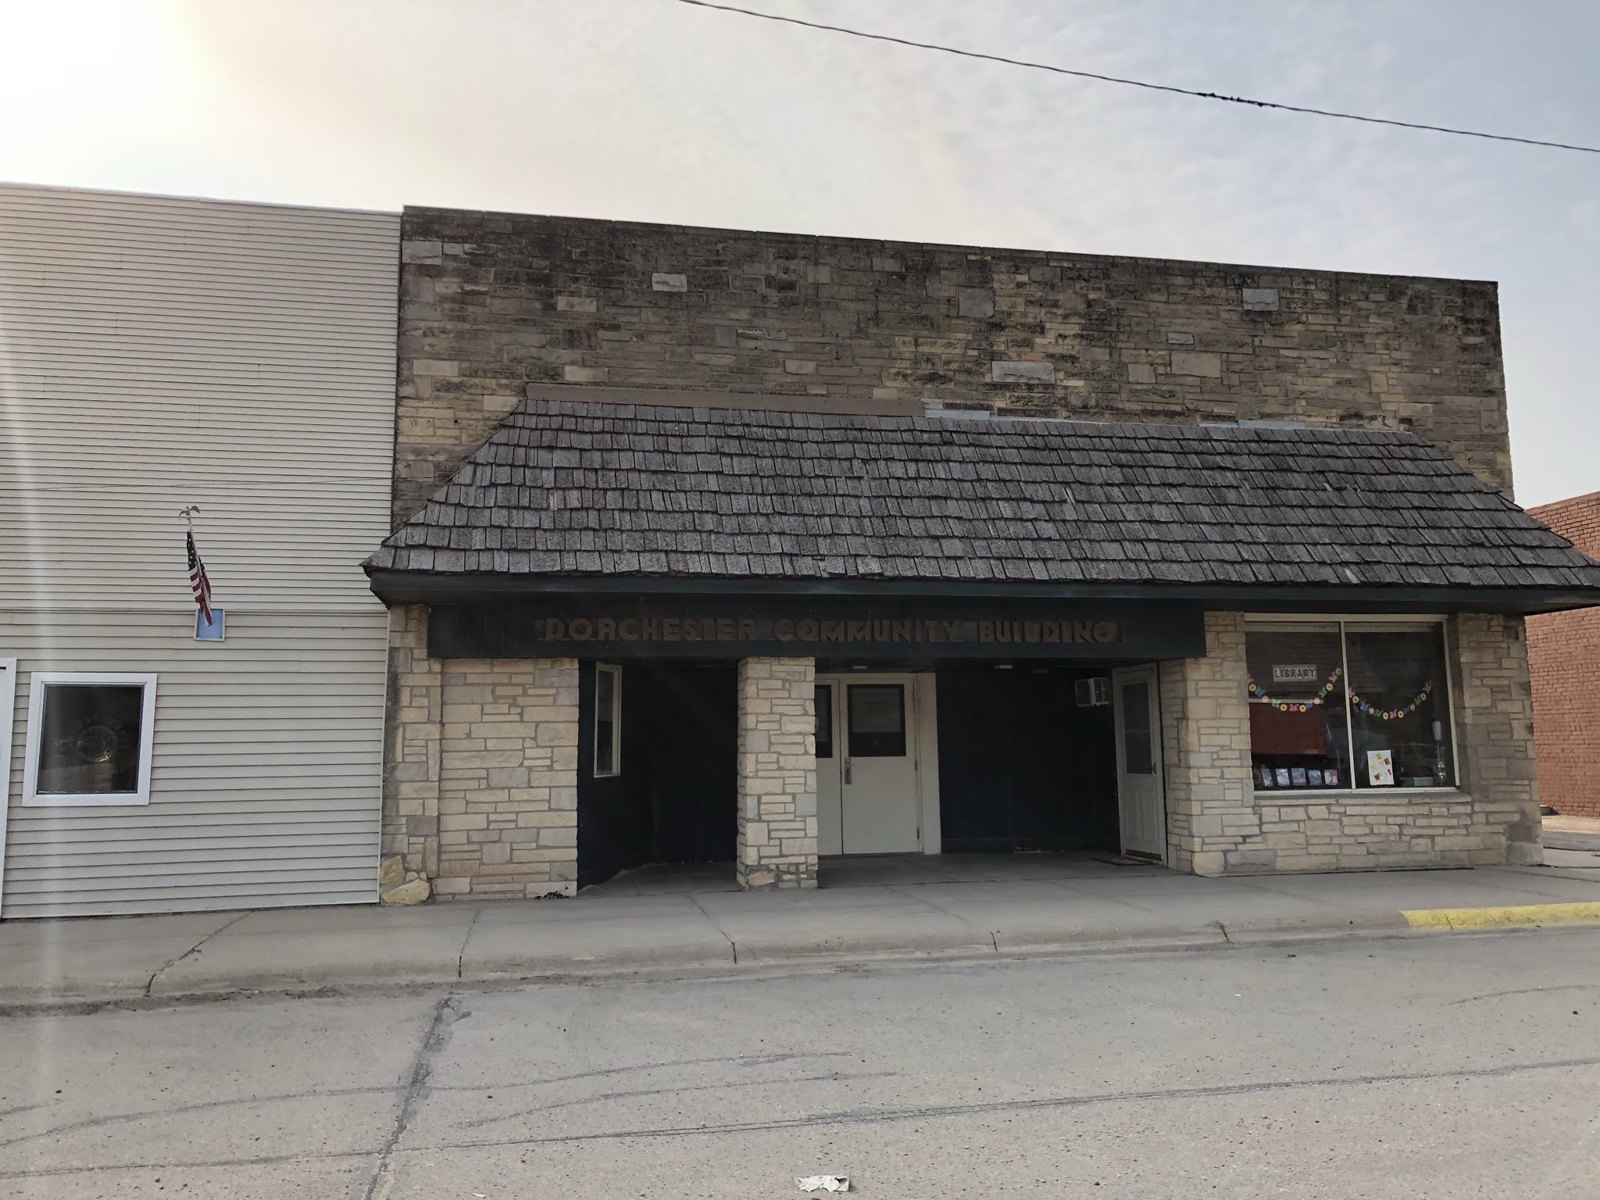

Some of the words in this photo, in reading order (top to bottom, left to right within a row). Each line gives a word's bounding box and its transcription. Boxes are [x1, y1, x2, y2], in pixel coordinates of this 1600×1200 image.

[545, 617, 755, 641] DORCHESTER
[773, 618, 960, 642] COMMUNITY
[979, 620, 1116, 643] BUILDING
[1274, 668, 1315, 678] LIBRARY
